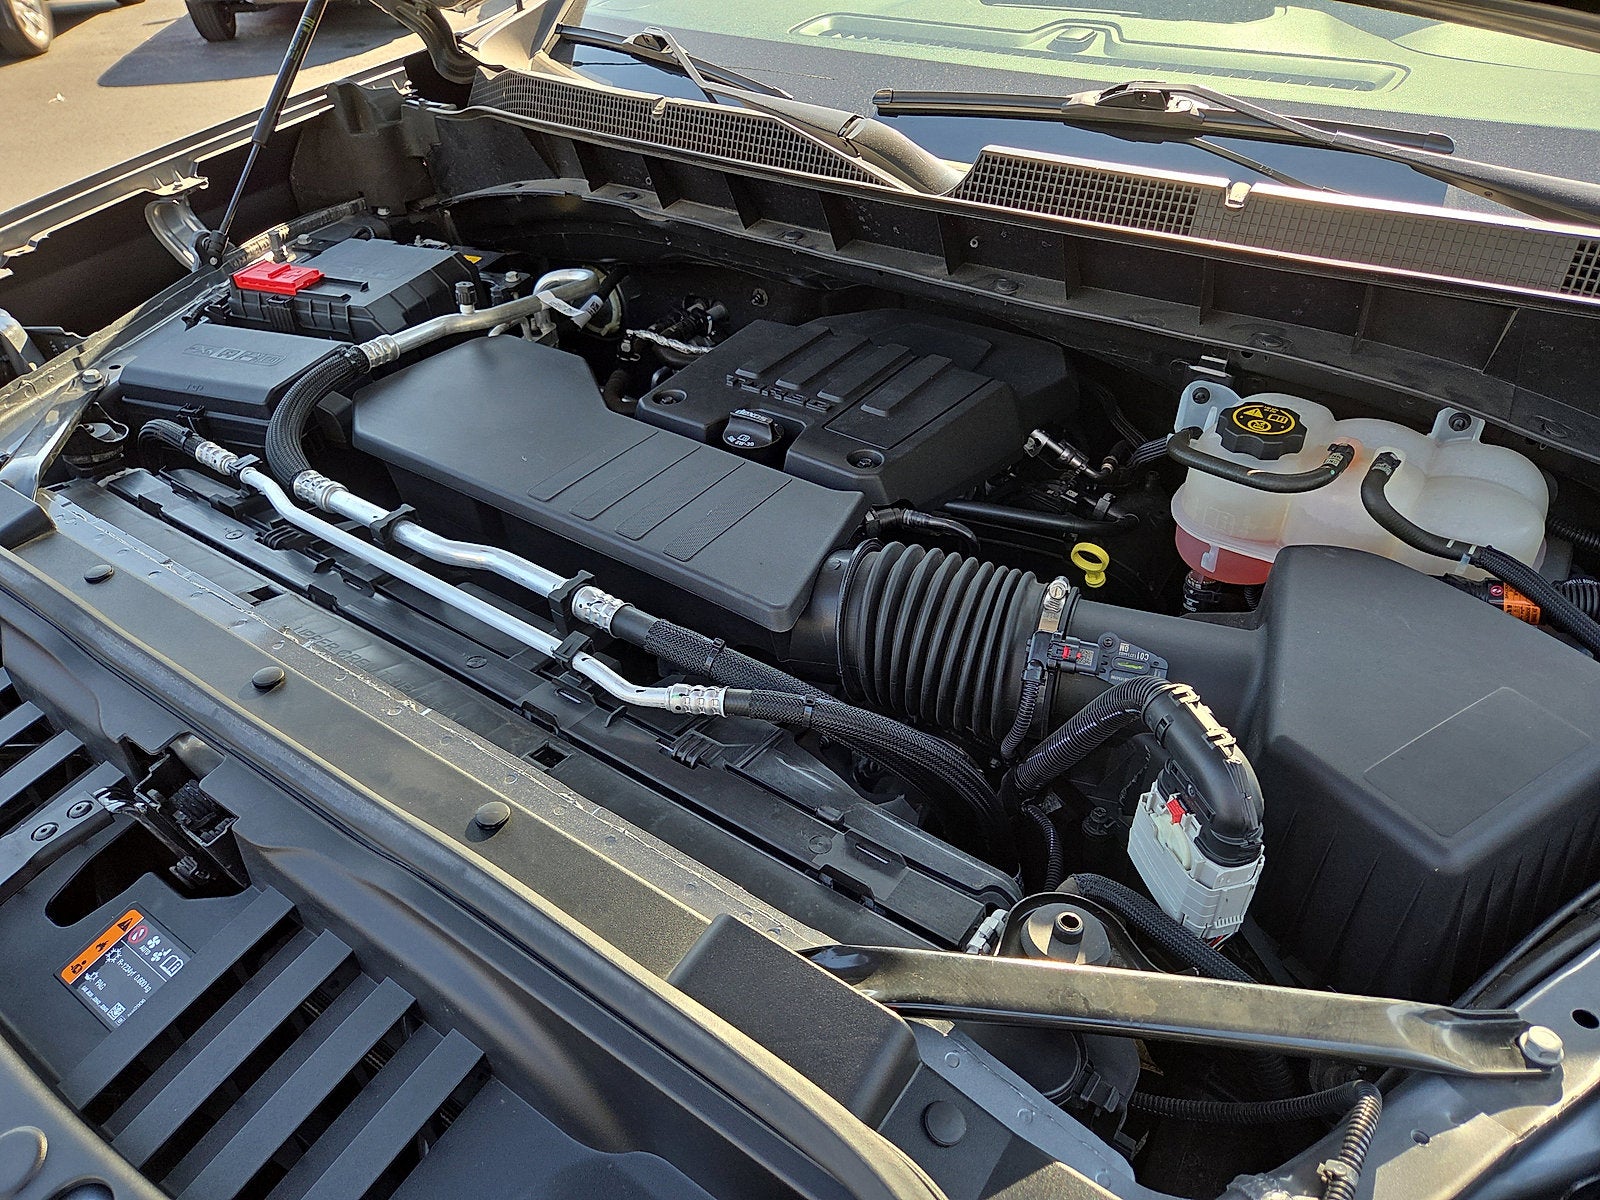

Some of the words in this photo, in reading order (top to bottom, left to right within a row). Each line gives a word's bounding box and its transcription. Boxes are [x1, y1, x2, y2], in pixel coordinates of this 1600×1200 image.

[294, 625, 340, 652] UPPER
[139, 945, 151, 956] AUTO
[117, 958, 136, 977] R-1234yf
[134, 973, 148, 988] 0.600
